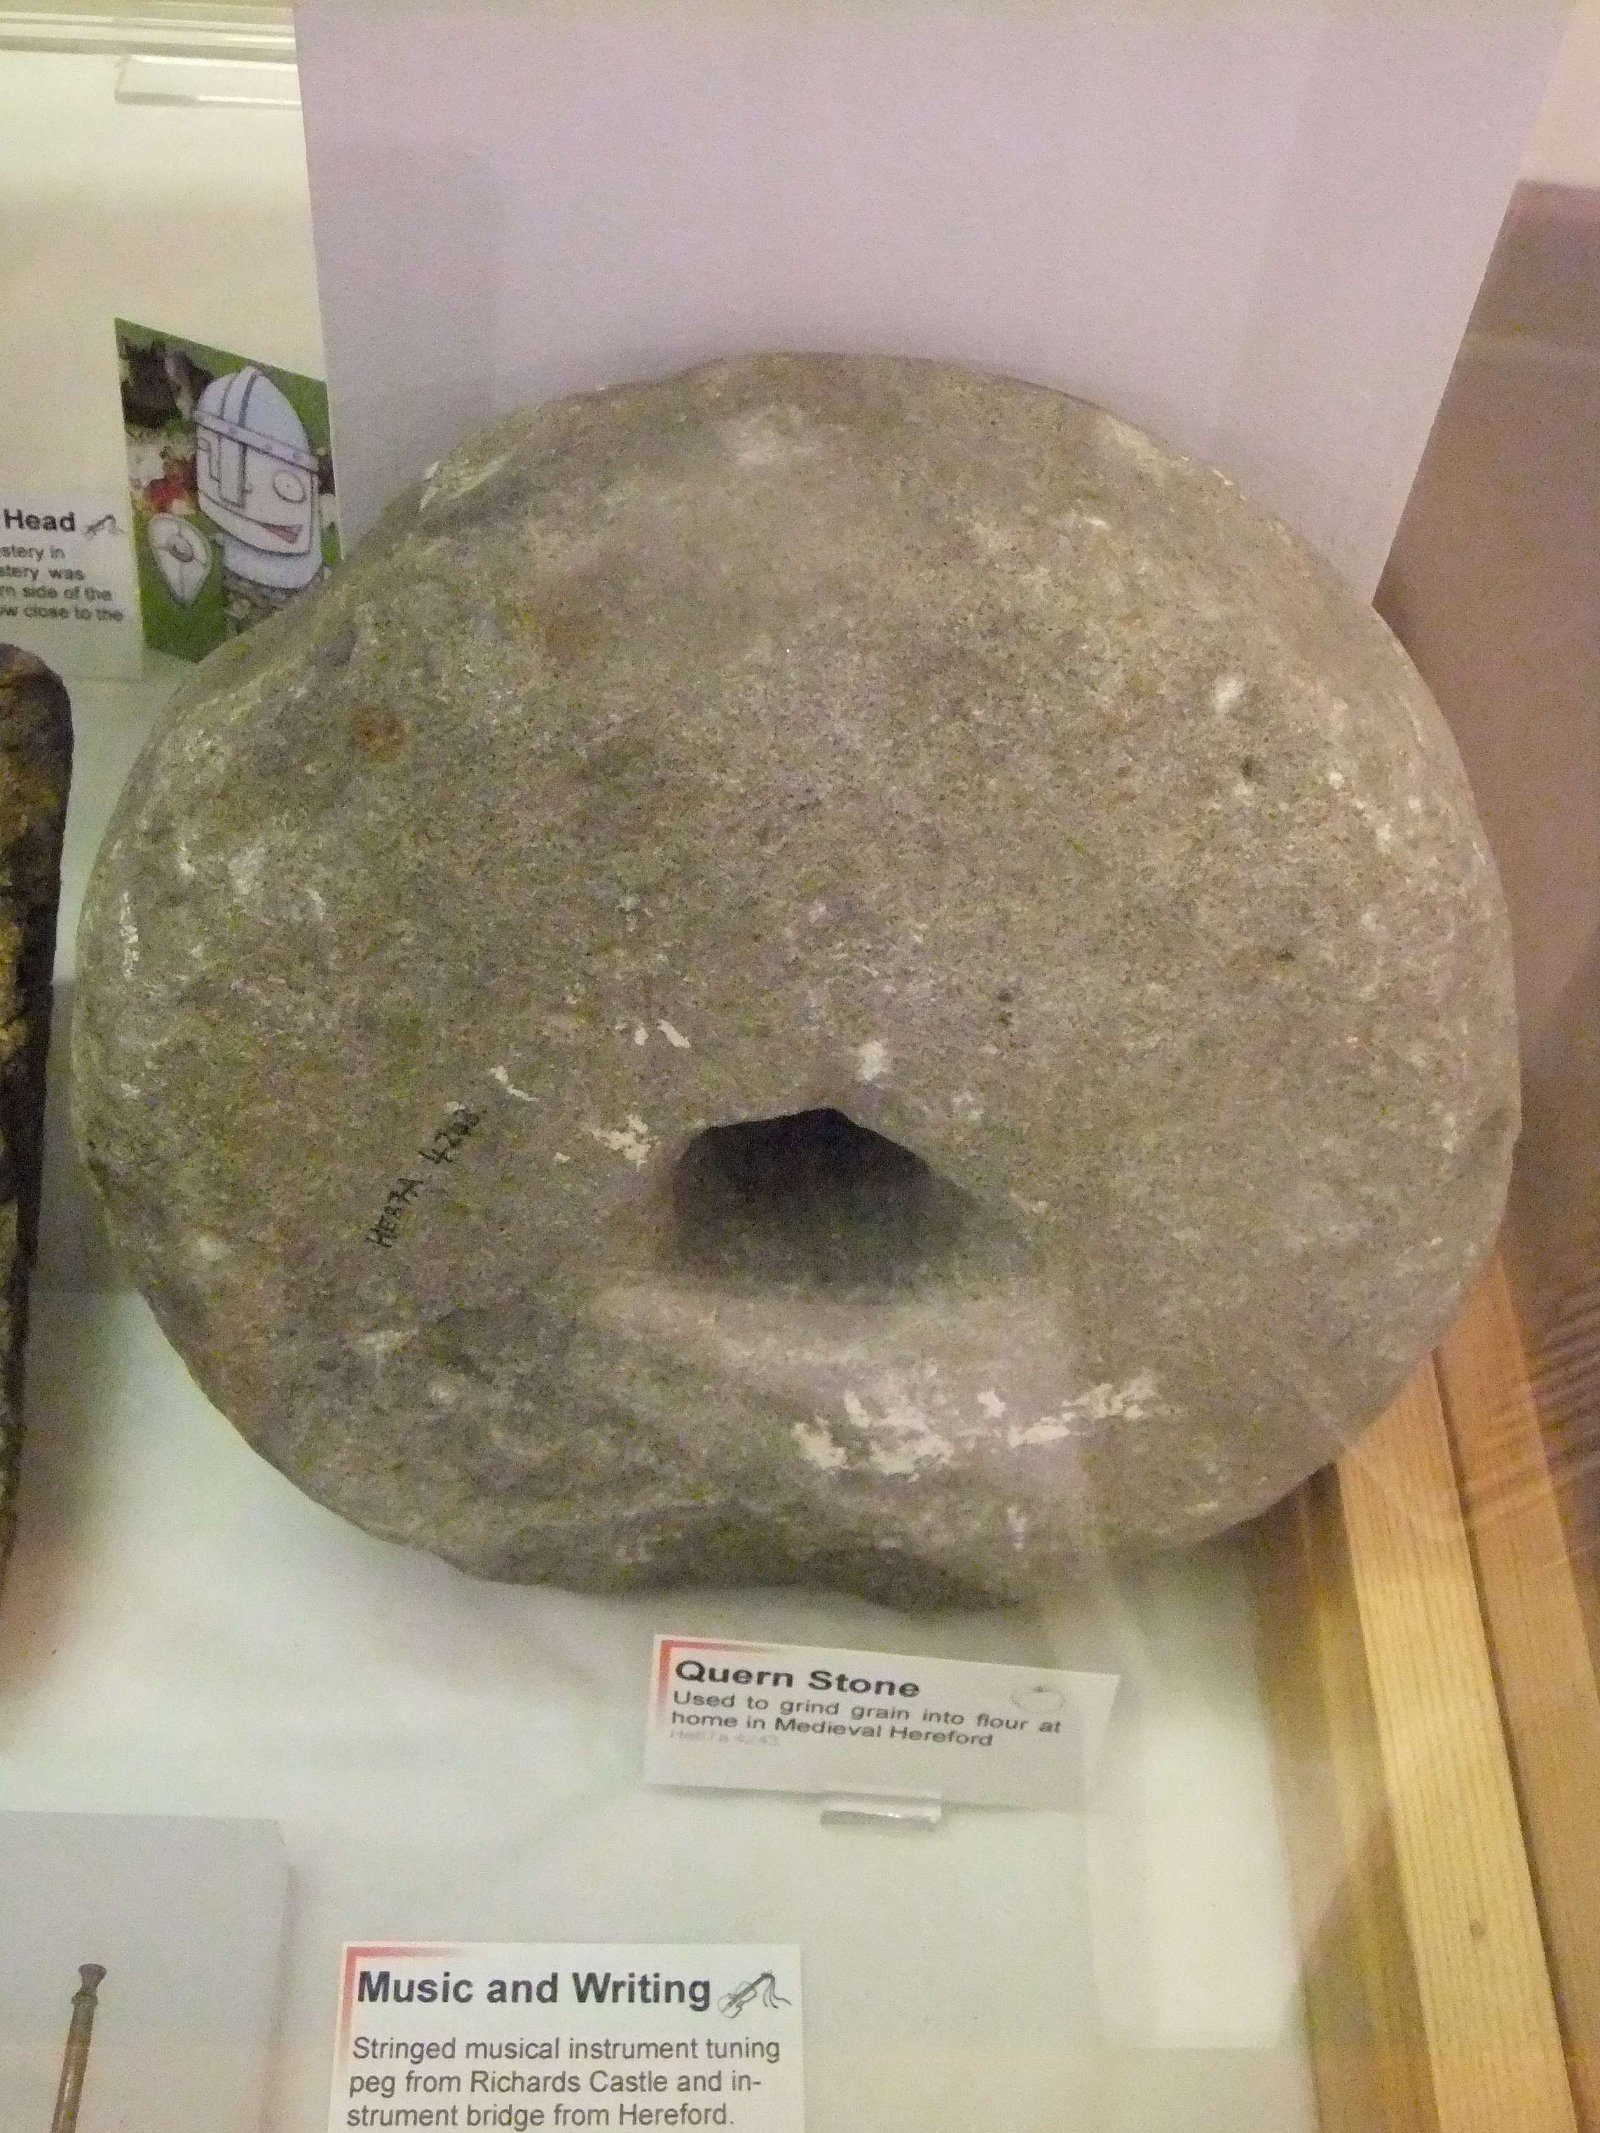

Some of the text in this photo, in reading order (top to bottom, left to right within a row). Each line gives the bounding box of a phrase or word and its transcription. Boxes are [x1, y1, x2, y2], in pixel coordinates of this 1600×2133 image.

[4, 508, 77, 532] Head
[49, 545, 67, 560] in
[48, 569, 86, 582] was
[23, 586, 59, 600] side
[64, 587, 81, 601] of
[85, 588, 114, 604] the
[23, 608, 70, 620] close
[75, 607, 93, 622] to
[97, 609, 127, 623] the
[674, 1660, 921, 1699] Quern Stone
[673, 1690, 1063, 1735] Used to grind grain into flour at
[672, 1710, 994, 1747] home in Medieval Hereford
[358, 1970, 711, 2012] Music and Writing
[352, 2036, 780, 2064] Stringed musical instrument tuning
[349, 2069, 762, 2098] peg from Richards Castle and in-
[347, 2104, 735, 2131] strument bridge from Hereford.
